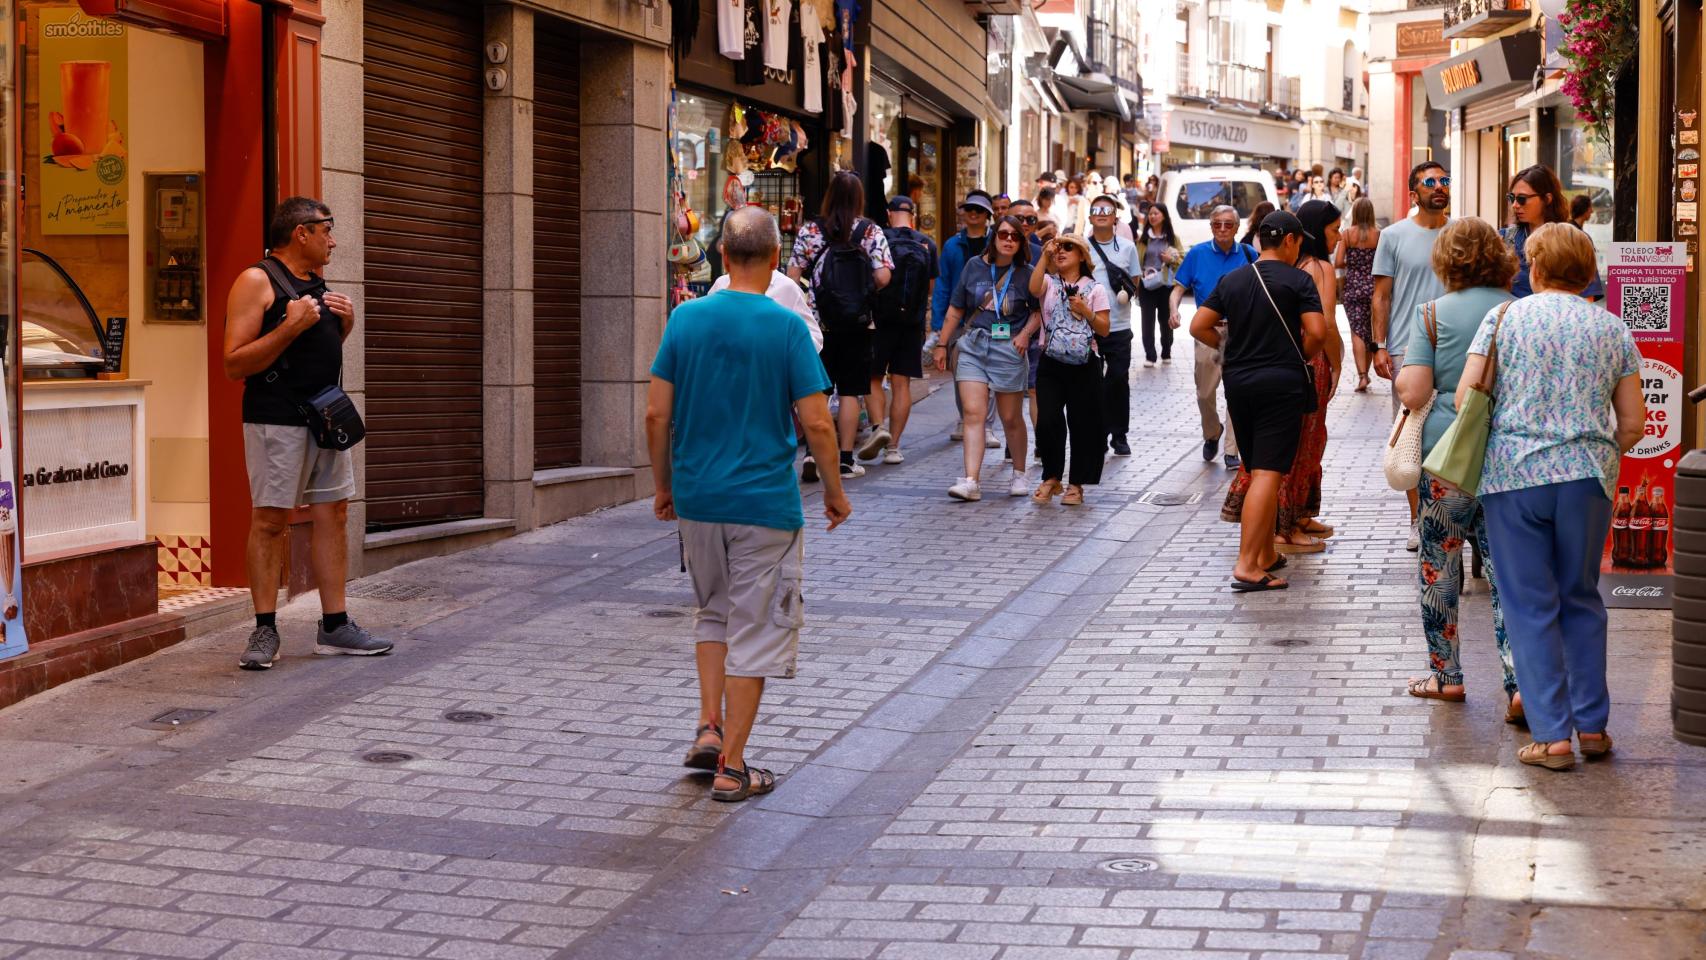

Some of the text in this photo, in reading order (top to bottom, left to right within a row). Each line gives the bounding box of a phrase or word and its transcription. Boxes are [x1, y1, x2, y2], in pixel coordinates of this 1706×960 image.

[45, 20, 124, 37] smoothies
[1183, 120, 1247, 143] VESTOPAZZO
[65, 190, 127, 216] momento
[1620, 247, 1654, 255] TOLEDO
[1609, 268, 1643, 276] ¡COMPRA
[1656, 268, 1685, 276] TICKET!
[1617, 275, 1677, 284] TREN TURÍSTICO
[1651, 362, 1678, 380] FRÍAS
[1637, 440, 1671, 455] DRINKS
[1611, 585, 1664, 597] Coca-Cola
